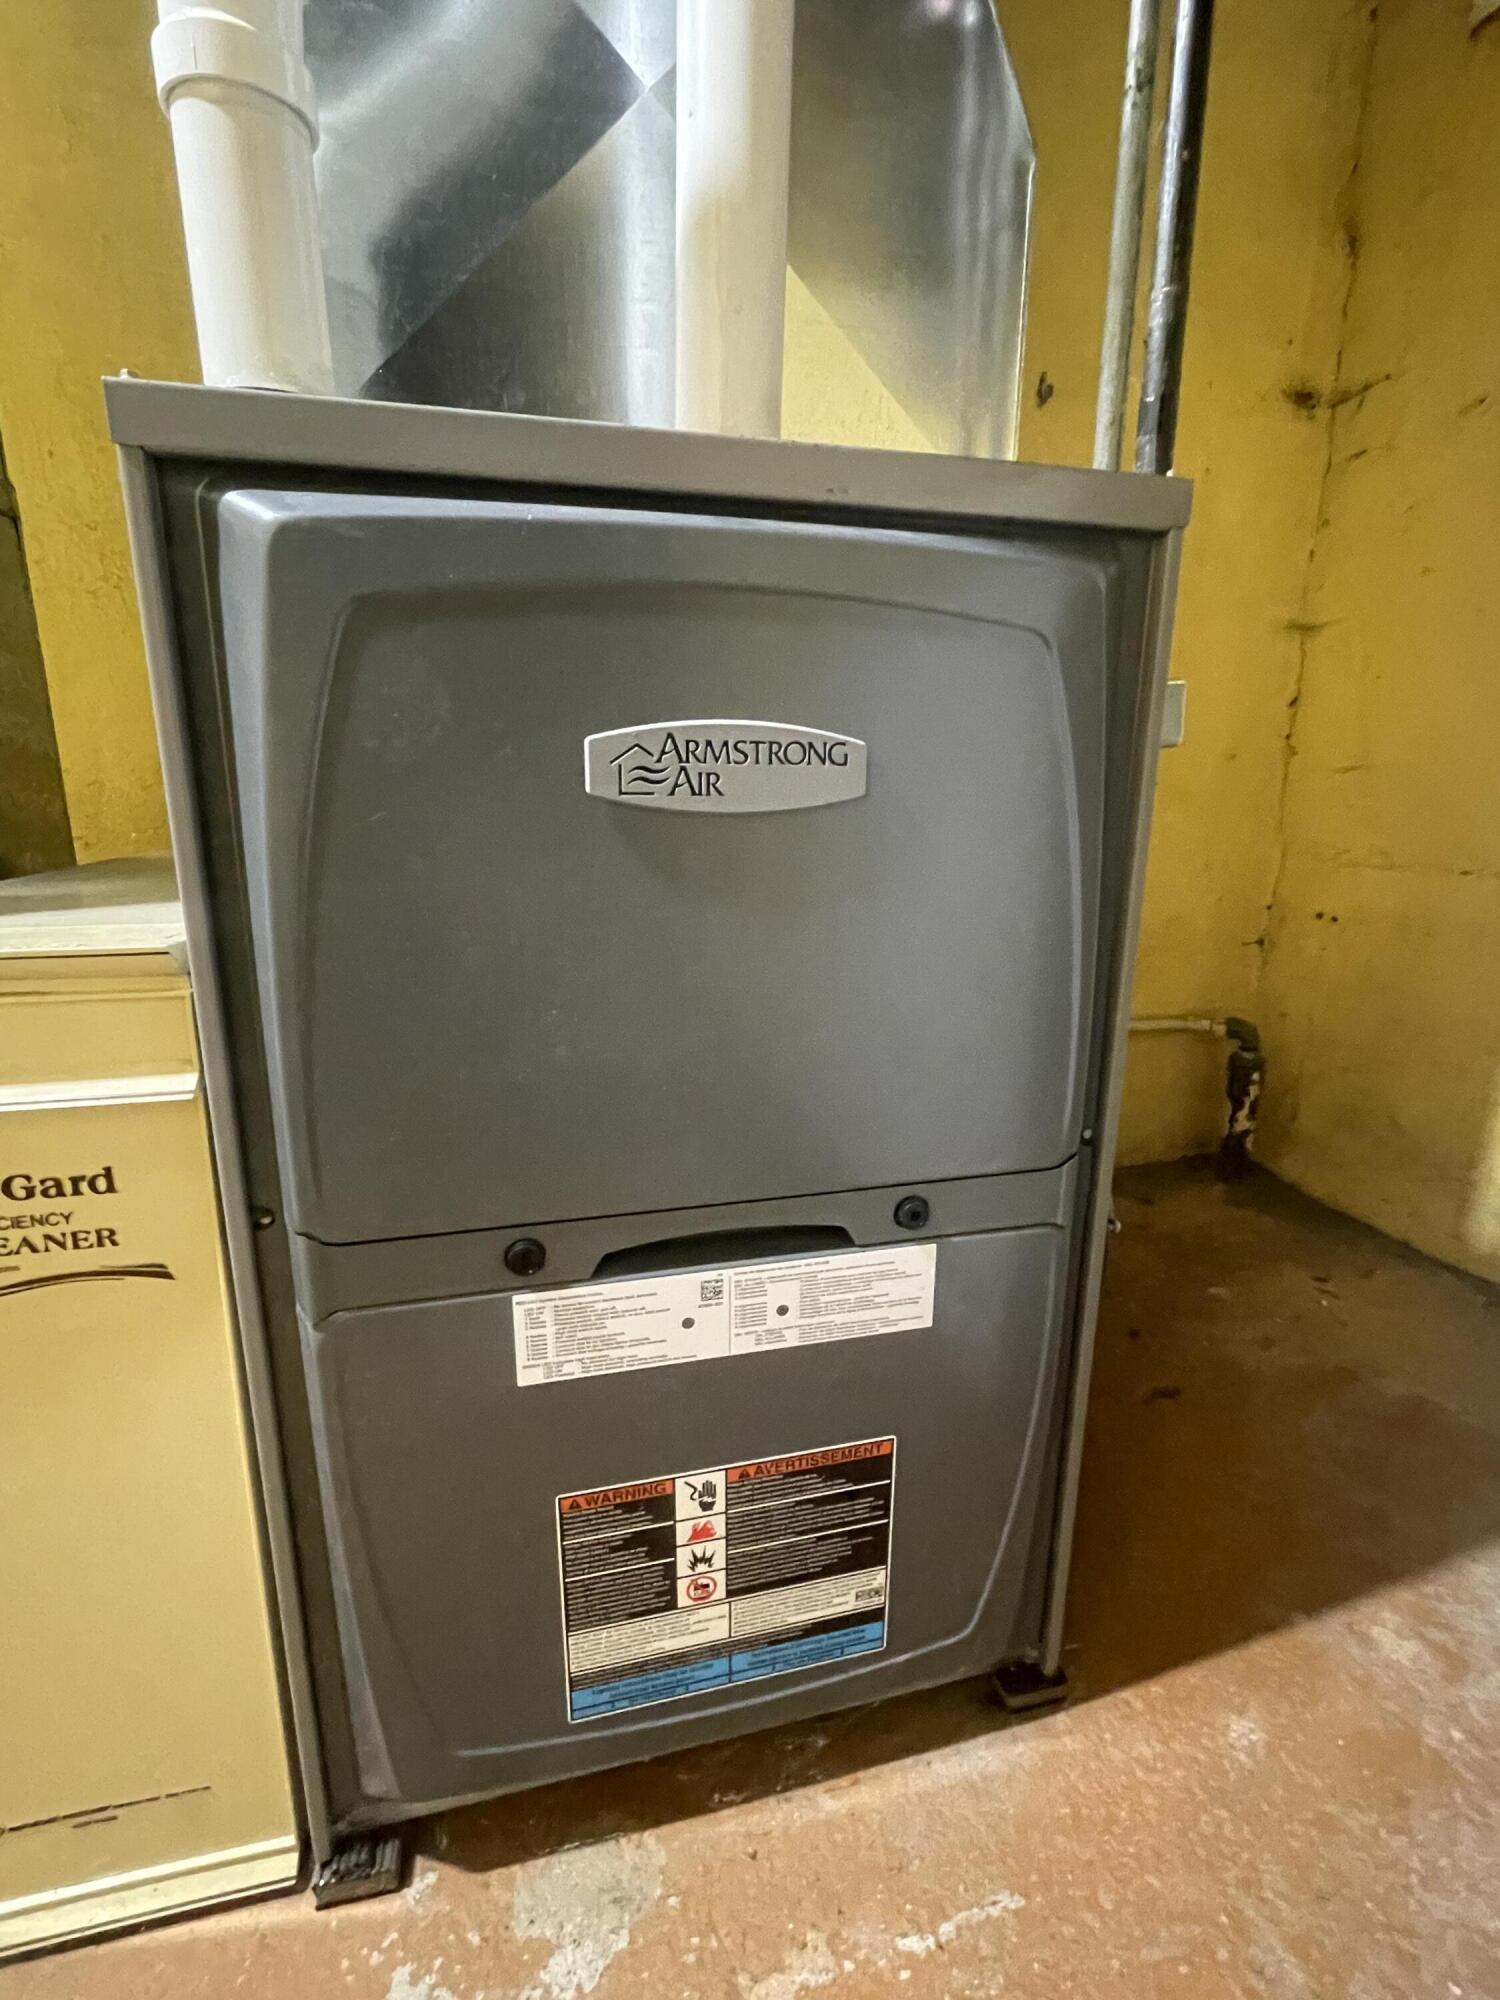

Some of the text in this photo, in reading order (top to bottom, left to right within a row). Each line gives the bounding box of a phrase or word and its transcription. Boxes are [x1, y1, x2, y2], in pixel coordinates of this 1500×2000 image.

[655, 732, 849, 767] ARMSTRONG
[1, 1165, 119, 1201] Gard
[753, 1444, 884, 1477] AVERTISSEMENT
[586, 1482, 667, 1507] WARNING
